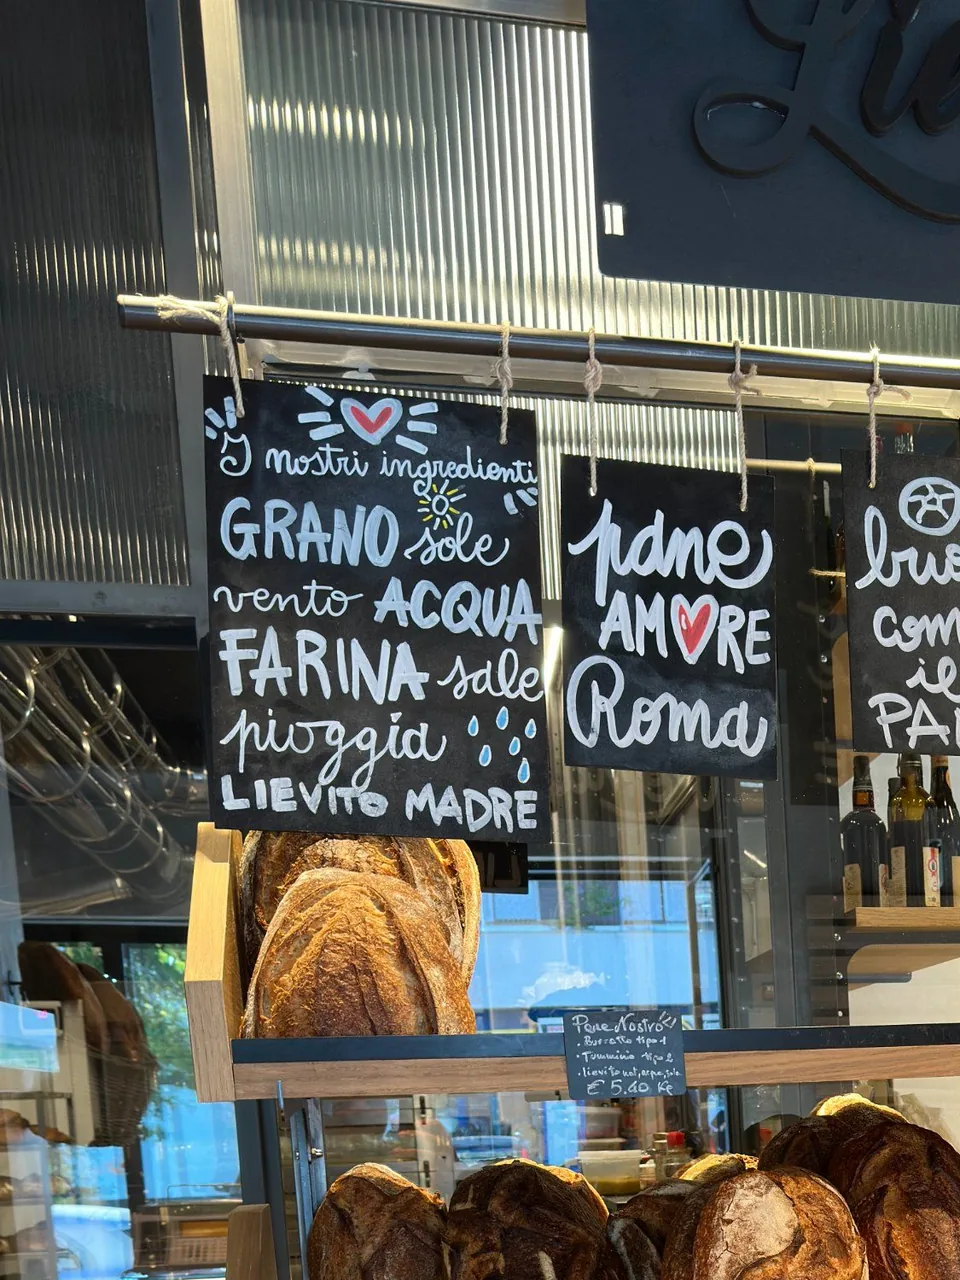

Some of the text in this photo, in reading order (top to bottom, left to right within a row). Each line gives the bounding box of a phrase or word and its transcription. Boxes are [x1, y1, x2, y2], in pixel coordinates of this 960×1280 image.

[265, 443, 369, 477] nostri
[379, 446, 538, 497] ingredienti
[220, 497, 510, 567] GRANO sole
[567, 498, 774, 606] pane
[214, 576, 543, 645] vento ACQUA
[218, 626, 544, 705] FARINA sale
[565, 655, 769, 758] Roma
[219, 708, 447, 793] pioggia
[220, 773, 538, 833] LIEVITO MADRE
[572, 1014, 614, 1033] Pane
[583, 1066, 620, 1077] lievito
[587, 1080, 605, 1095] €
[641, 1052, 663, 1065] tipo
[665, 1053, 674, 1062] 2
